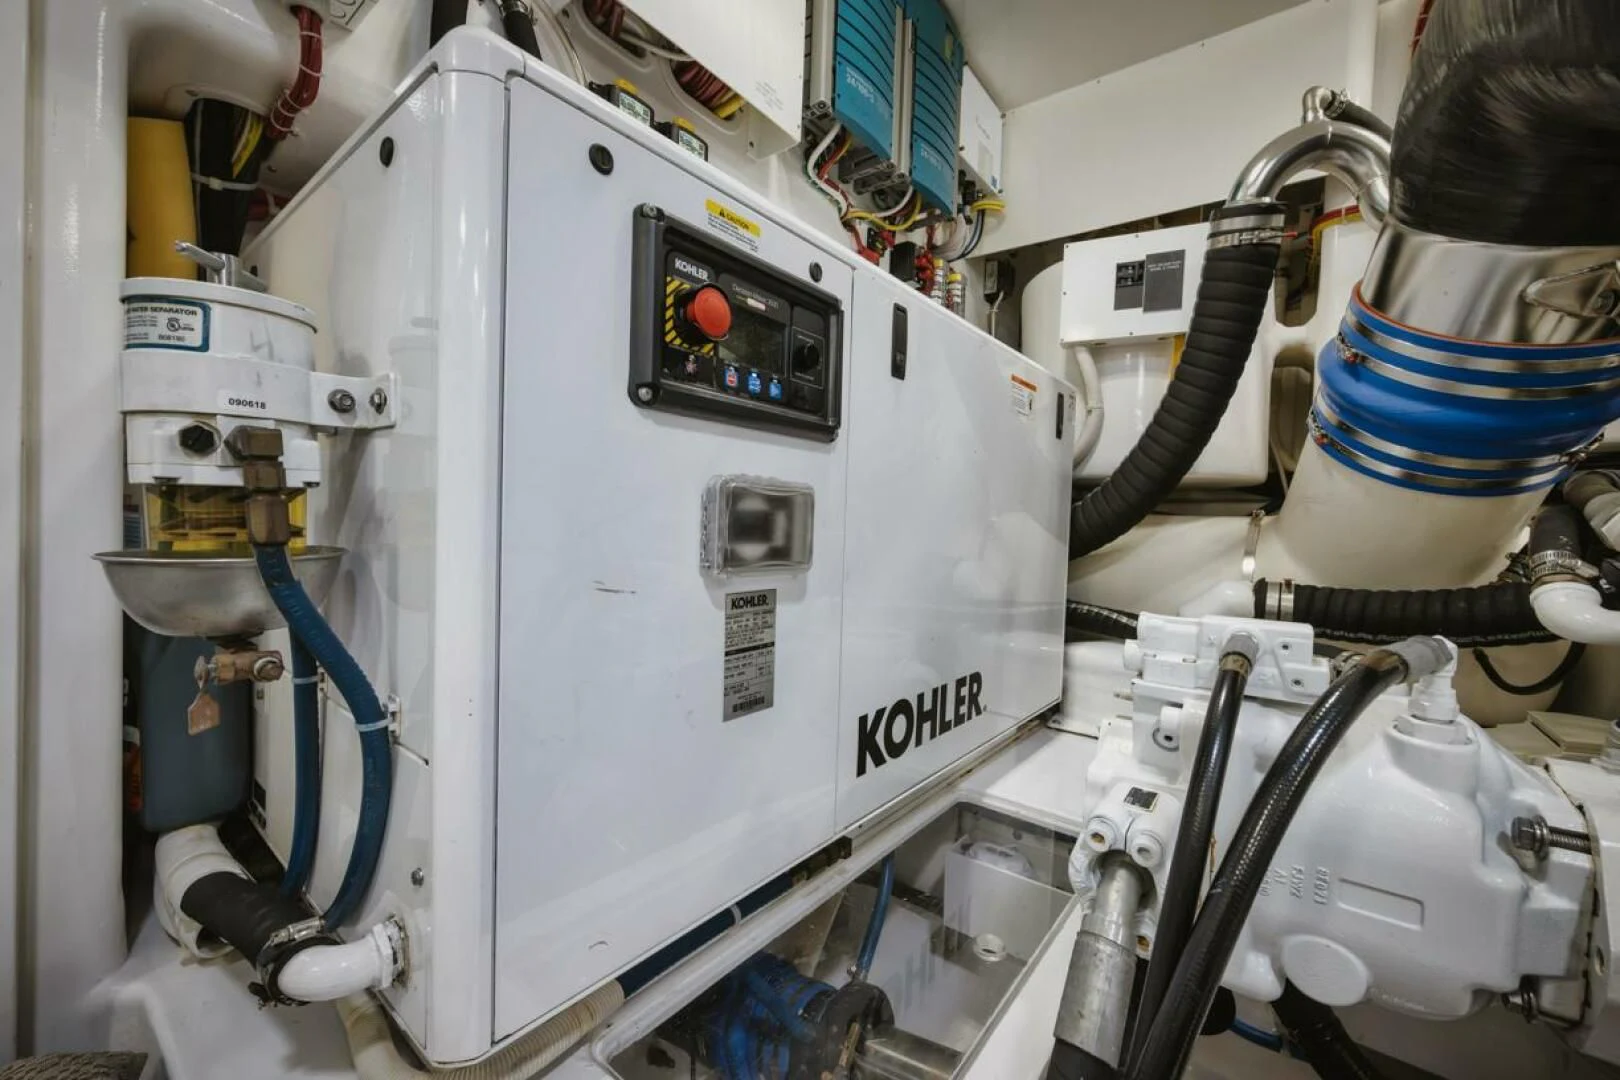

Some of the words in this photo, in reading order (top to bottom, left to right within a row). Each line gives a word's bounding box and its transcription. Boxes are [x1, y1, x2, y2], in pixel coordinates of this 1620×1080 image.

[675, 258, 709, 281] KOHLER
[150, 305, 198, 317] SEPARATOR
[228, 397, 267, 410] 090618
[731, 594, 769, 611] KOHLER
[856, 671, 983, 778] KOHLER
